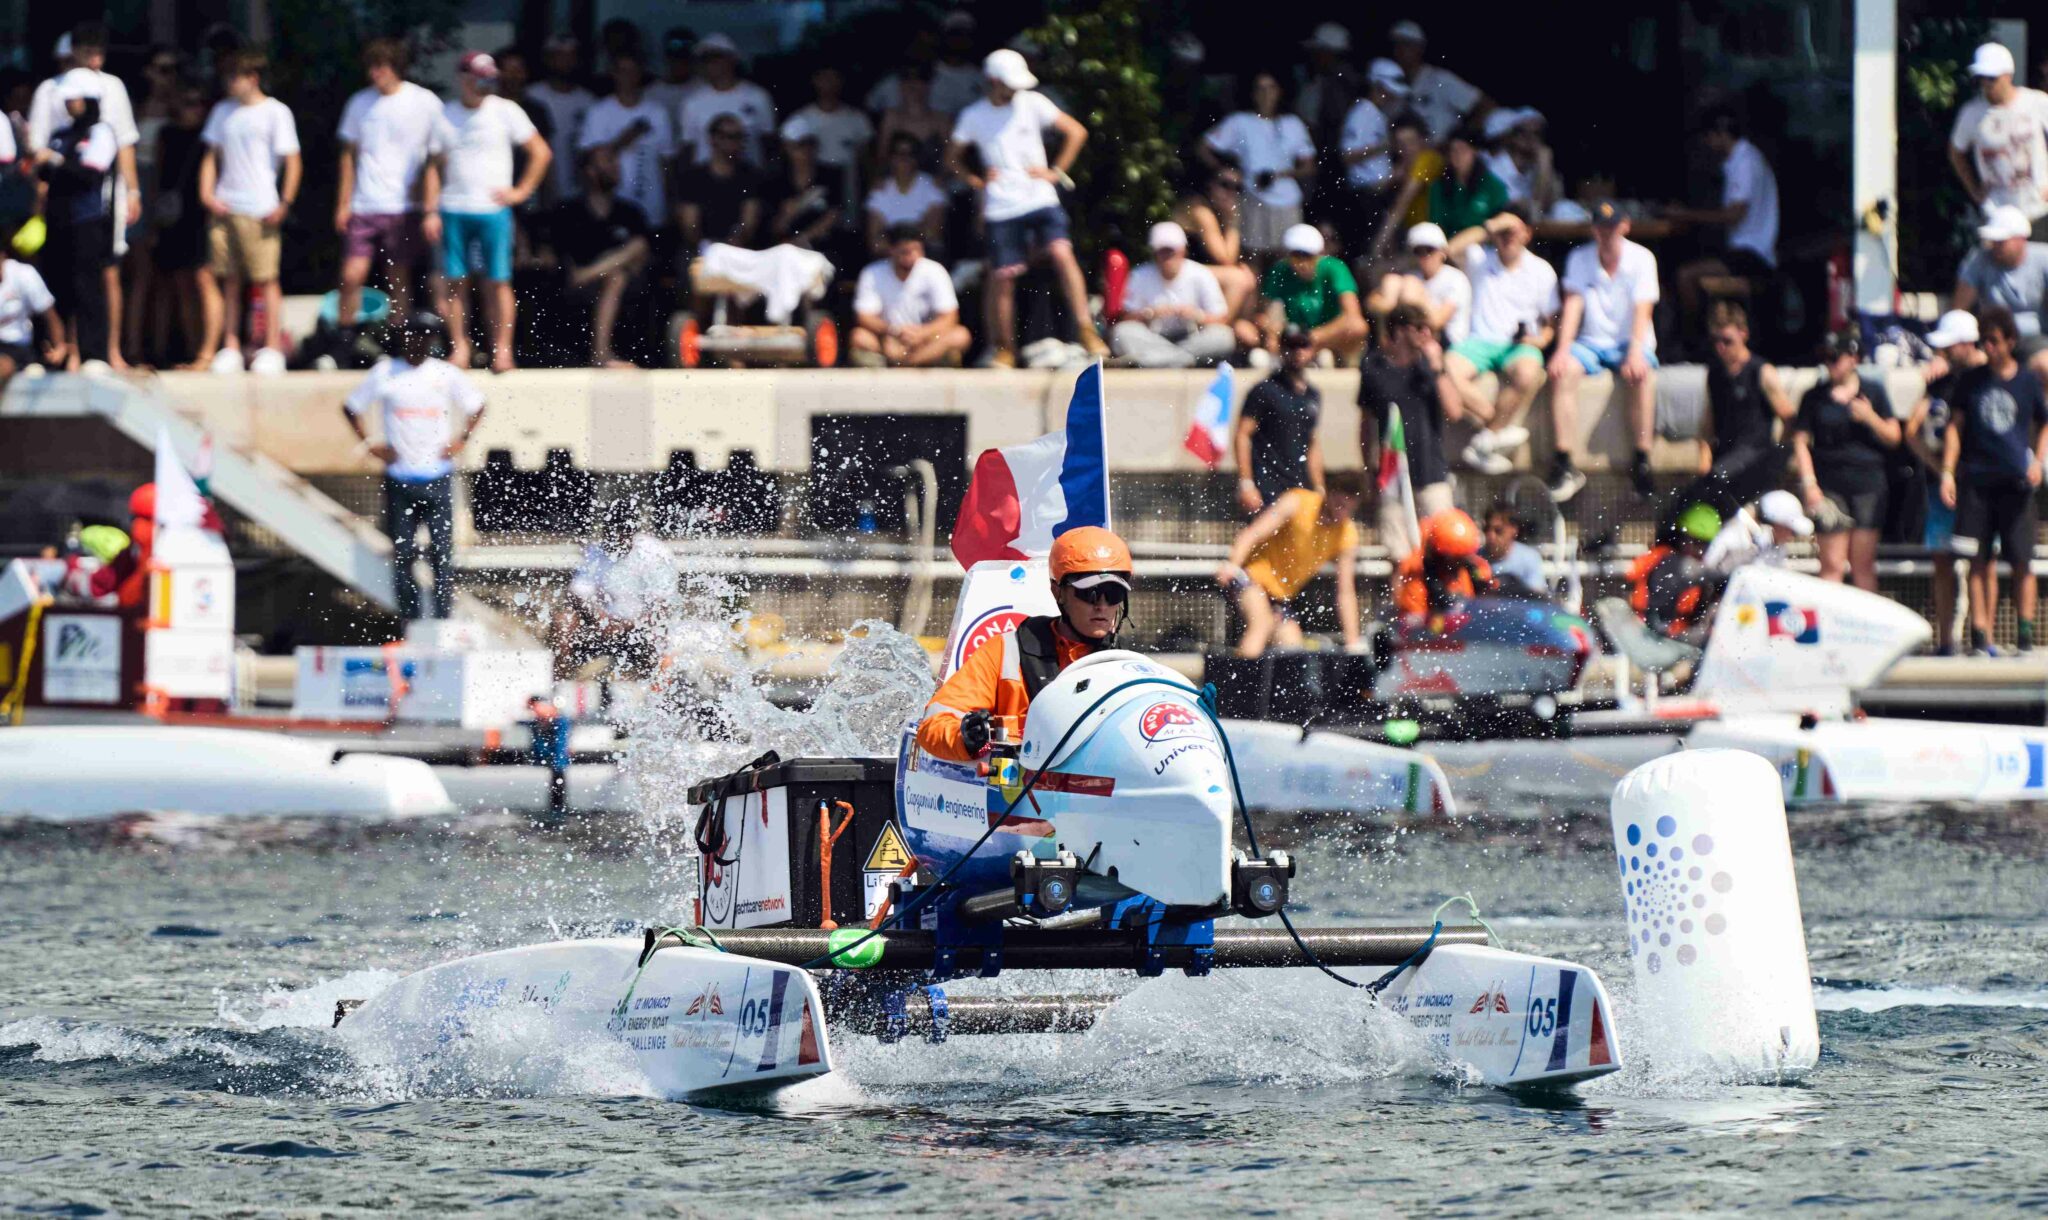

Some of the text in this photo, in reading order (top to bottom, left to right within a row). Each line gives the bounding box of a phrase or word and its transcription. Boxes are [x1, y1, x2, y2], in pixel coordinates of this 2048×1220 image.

[968, 617, 1018, 657] ONA
[1146, 704, 1194, 731] MONAC
[1154, 743, 1210, 776] Univer
[906, 786, 986, 824] Capgemini engineering
[736, 893, 785, 915] achtcarenetwork
[642, 996, 671, 1009] MONACO
[1425, 994, 1454, 1008] MONACO
[628, 1016, 669, 1031] ENERGY BOAT
[742, 998, 769, 1038] 05
[1434, 1013, 1452, 1028] BOAT
[1529, 997, 1557, 1037] 05
